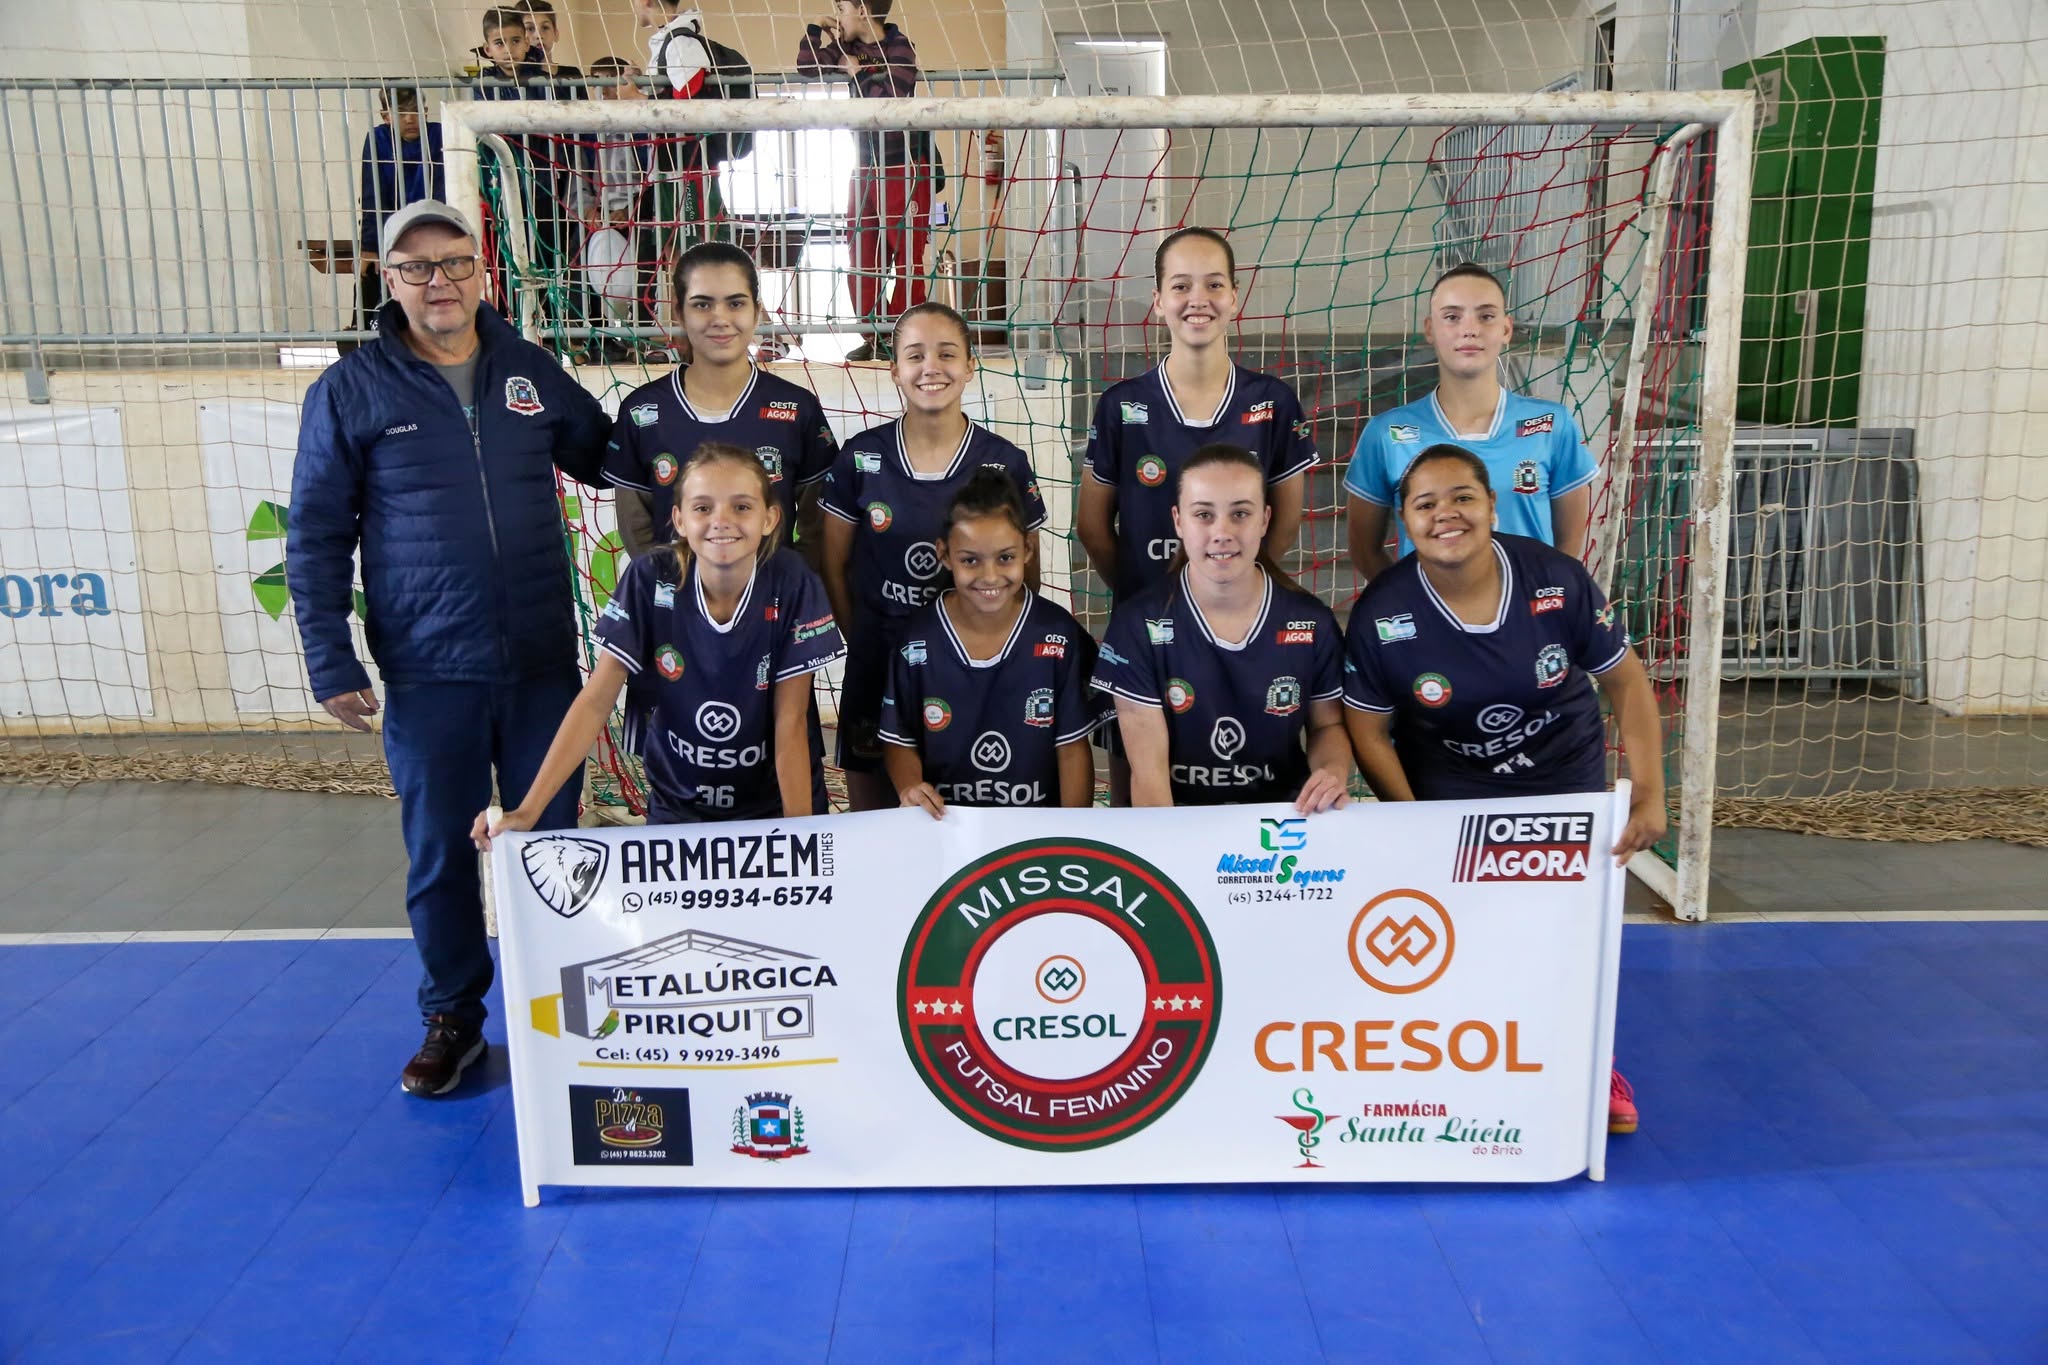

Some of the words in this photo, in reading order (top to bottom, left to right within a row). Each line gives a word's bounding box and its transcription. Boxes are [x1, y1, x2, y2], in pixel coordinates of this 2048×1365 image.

[769, 401, 798, 410] OESTE
[385, 423, 418, 436] DOUGLAS
[1524, 414, 1553, 426] OESTE
[881, 579, 938, 608] CRES
[1284, 632, 1313, 643] AGOR
[807, 651, 836, 668] Missal
[1442, 710, 1560, 758] CRESOL
[937, 779, 1046, 806] CRESOL
[1488, 815, 1589, 843] OESTE
[621, 829, 819, 883] ARMAZÉM
[822, 832, 834, 877] CLOTHES
[1216, 853, 1279, 873] Missal
[1477, 850, 1589, 879] AGORA
[1217, 875, 1262, 884] CORRETORA
[1264, 875, 1274, 883] DE
[1275, 855, 1346, 888] Seguros
[648, 890, 678, 906] (45)
[681, 886, 834, 910] 99934-6574
[957, 863, 1149, 929] MISSAL
[1228, 891, 1252, 905] (45)
[1256, 887, 1334, 902] 3244-1722
[588, 963, 838, 1000] METALÚRGICA
[624, 1005, 803, 1038] PIRIQUITO
[992, 1013, 1127, 1041] CRESOL
[596, 1047, 631, 1061] Cel:
[635, 1048, 669, 1063] (45)
[679, 1050, 688, 1062] 9
[694, 1046, 780, 1062] 9929-3496
[1254, 1019, 1544, 1073] CRESOL
[945, 1040, 1041, 1117] FUTSAL
[1049, 1037, 1174, 1118] FEMININO
[1363, 1099, 1448, 1117] FARMÁCIA
[1339, 1116, 1426, 1144] Santa
[1434, 1116, 1523, 1144] Lúcia
[1472, 1145, 1488, 1155] do
[1491, 1144, 1523, 1156] Brito
